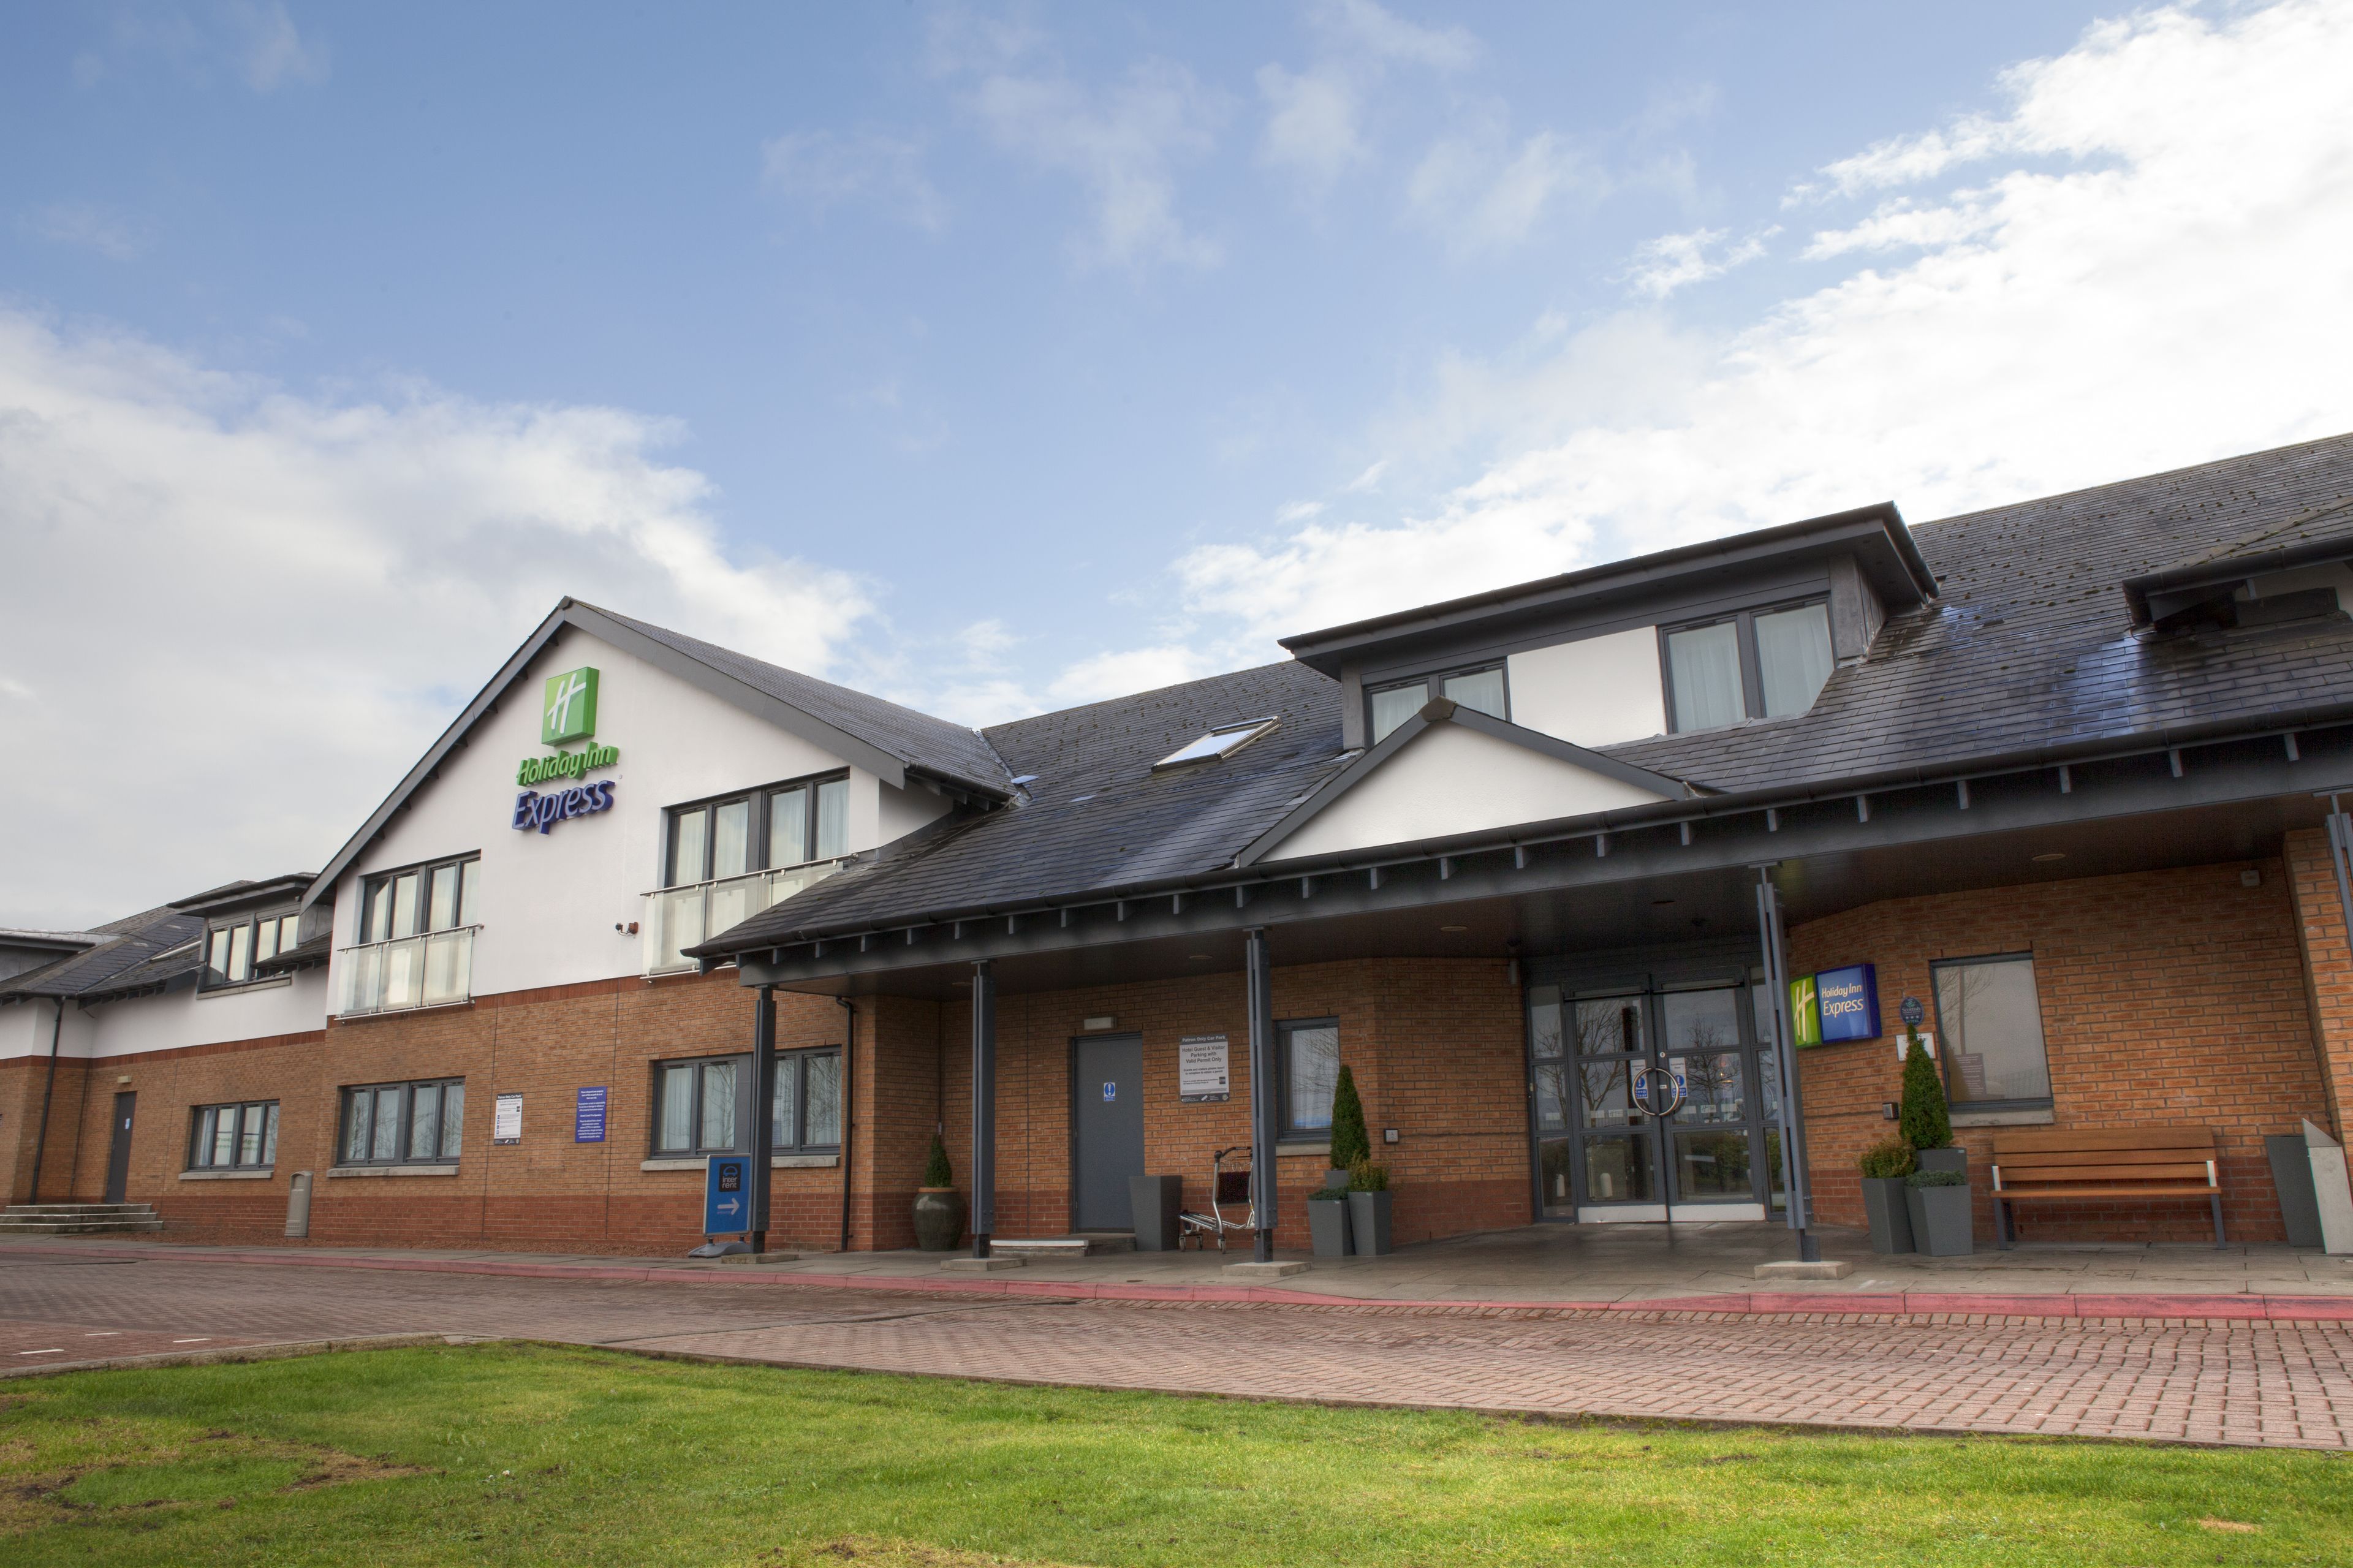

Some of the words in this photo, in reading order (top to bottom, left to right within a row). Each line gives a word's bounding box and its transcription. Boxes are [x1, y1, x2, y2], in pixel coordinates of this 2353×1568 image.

[547, 673, 586, 734] H
[517, 749, 585, 786] Holiday
[583, 741, 618, 770] Inn
[512, 780, 616, 835] Express
[1794, 980, 1814, 1042] H
[1822, 985, 1848, 998] Holiday
[1849, 983, 1862, 993] Inn
[1824, 998, 1863, 1018] Express
